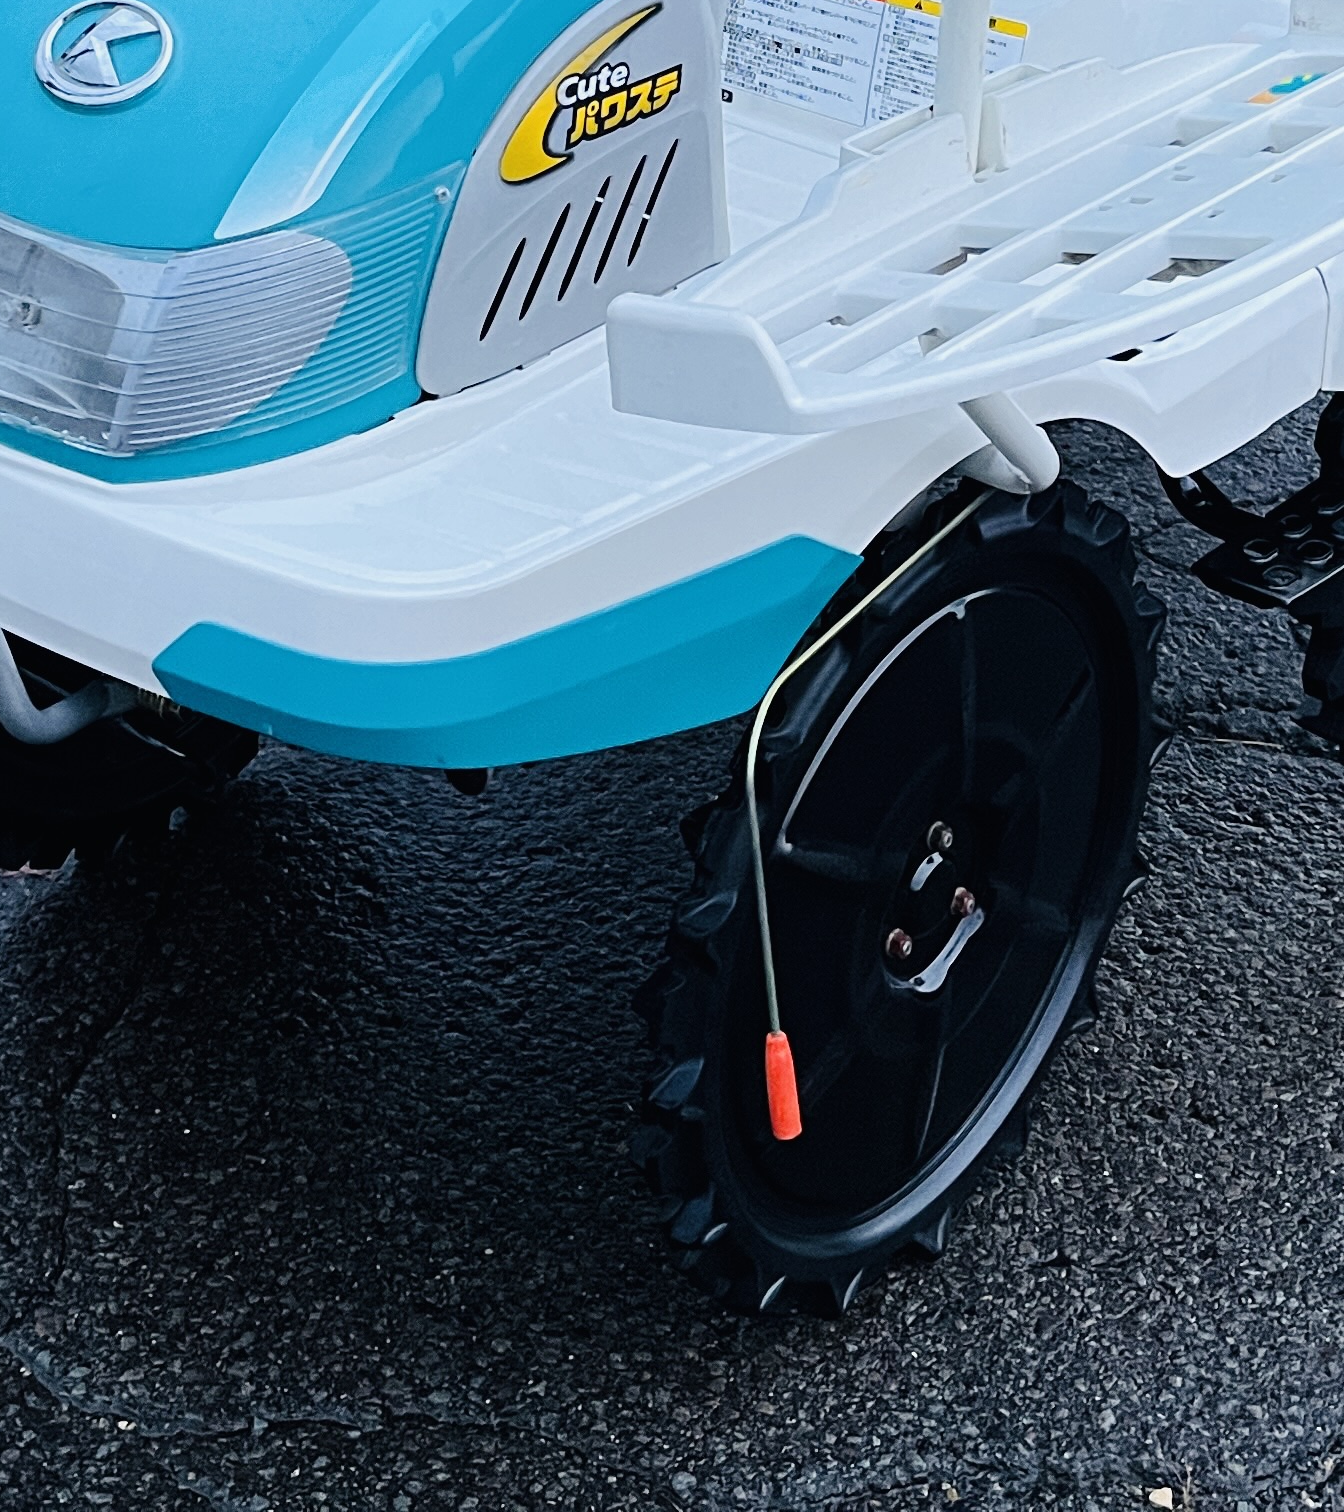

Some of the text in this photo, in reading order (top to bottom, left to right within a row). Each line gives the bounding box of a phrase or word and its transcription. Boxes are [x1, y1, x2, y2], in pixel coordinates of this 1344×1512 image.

[557, 64, 629, 106] Cute
[570, 70, 679, 144] パワステ
